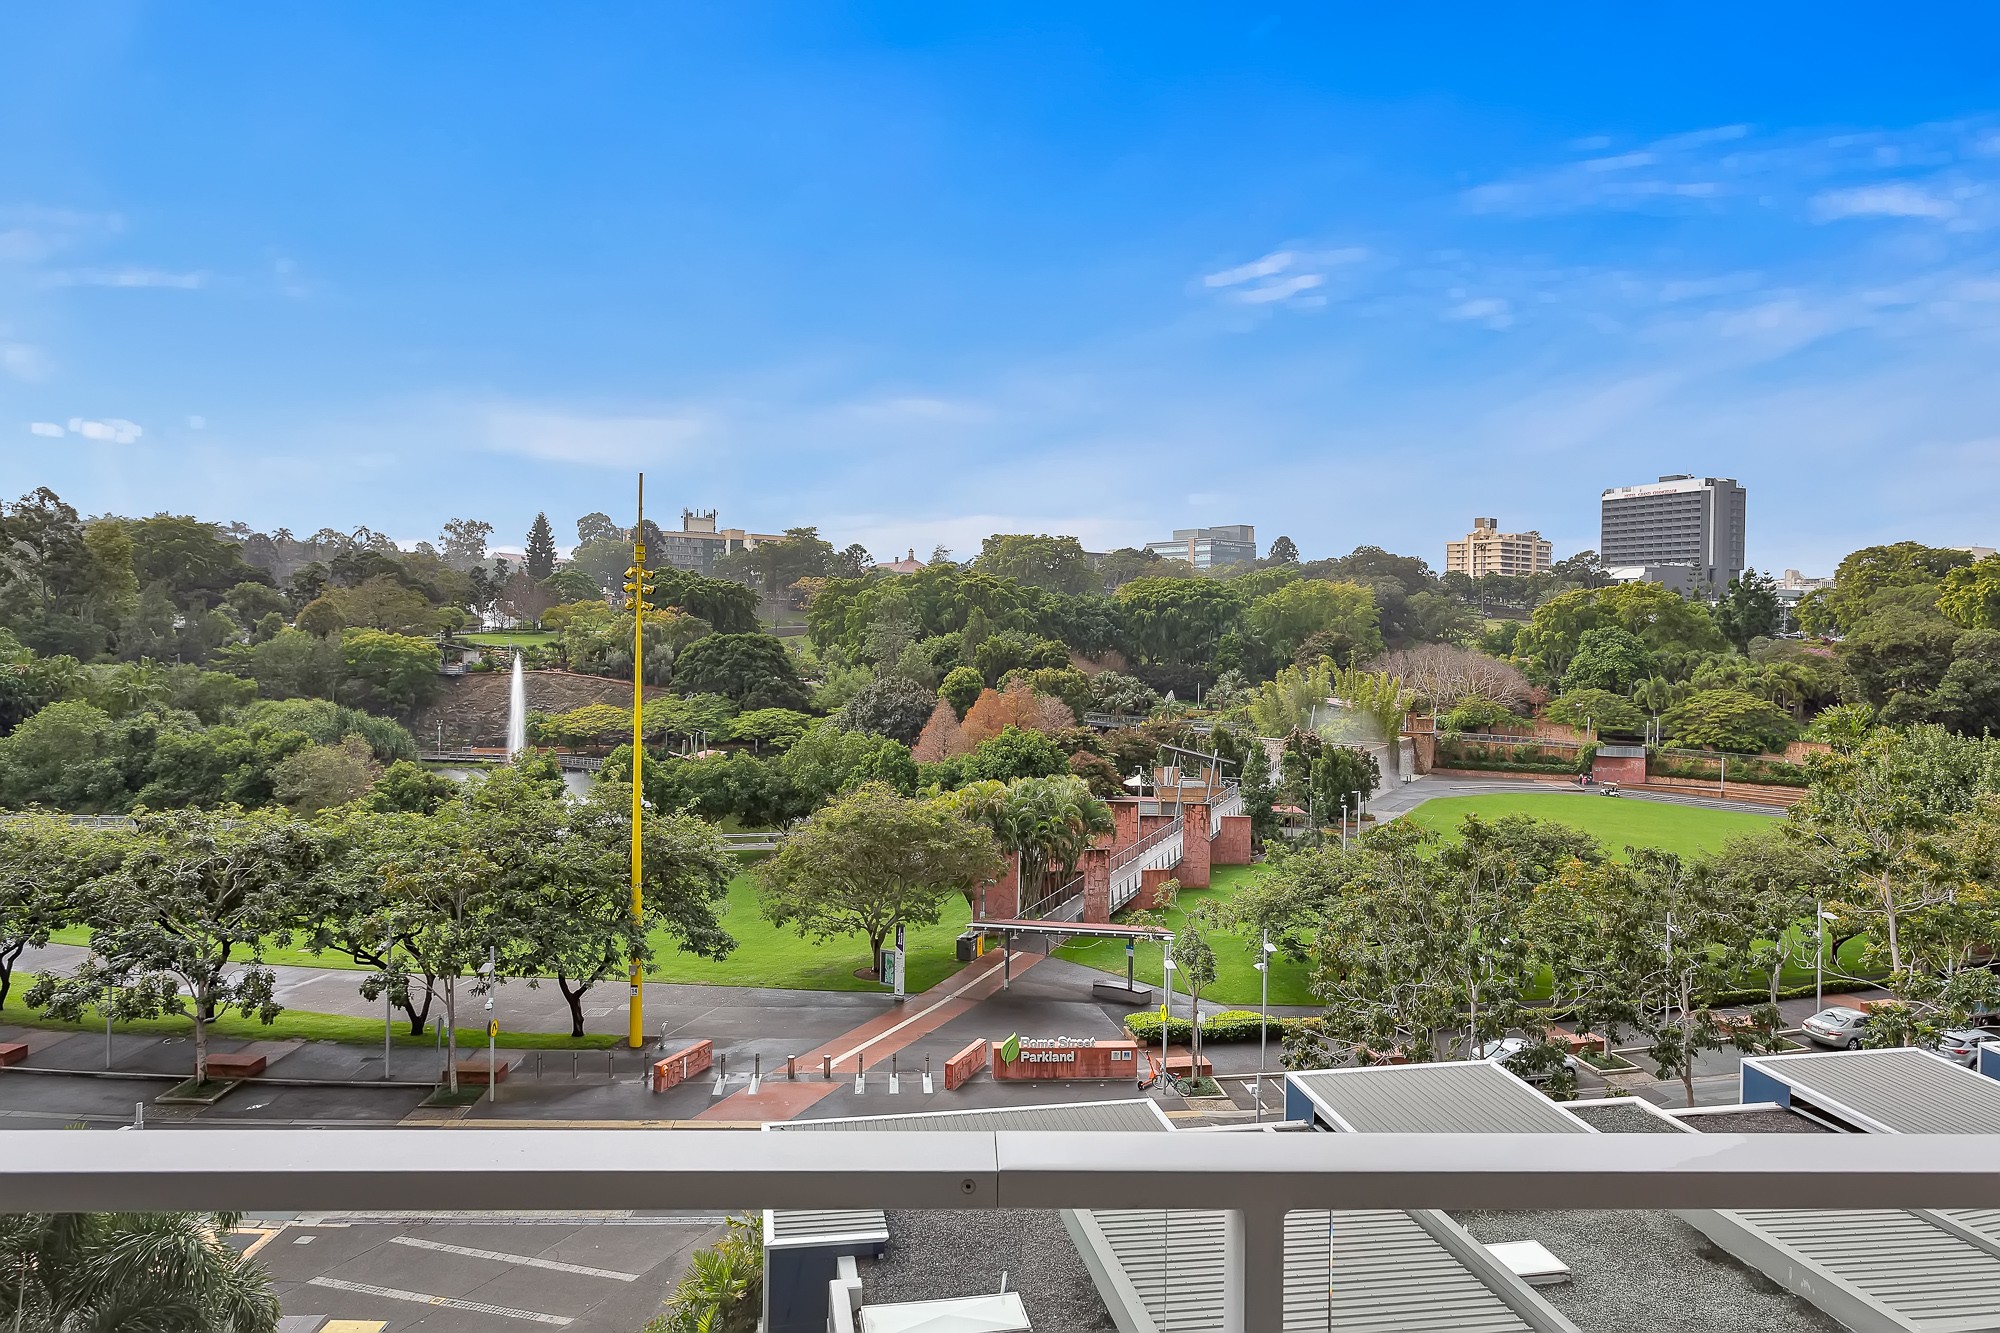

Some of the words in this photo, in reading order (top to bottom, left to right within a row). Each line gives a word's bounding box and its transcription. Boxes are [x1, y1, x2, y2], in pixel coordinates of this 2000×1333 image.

[1020, 1036, 1055, 1048] Roma
[1058, 1035, 1095, 1048] Street
[1020, 1051, 1075, 1062] Parkland
